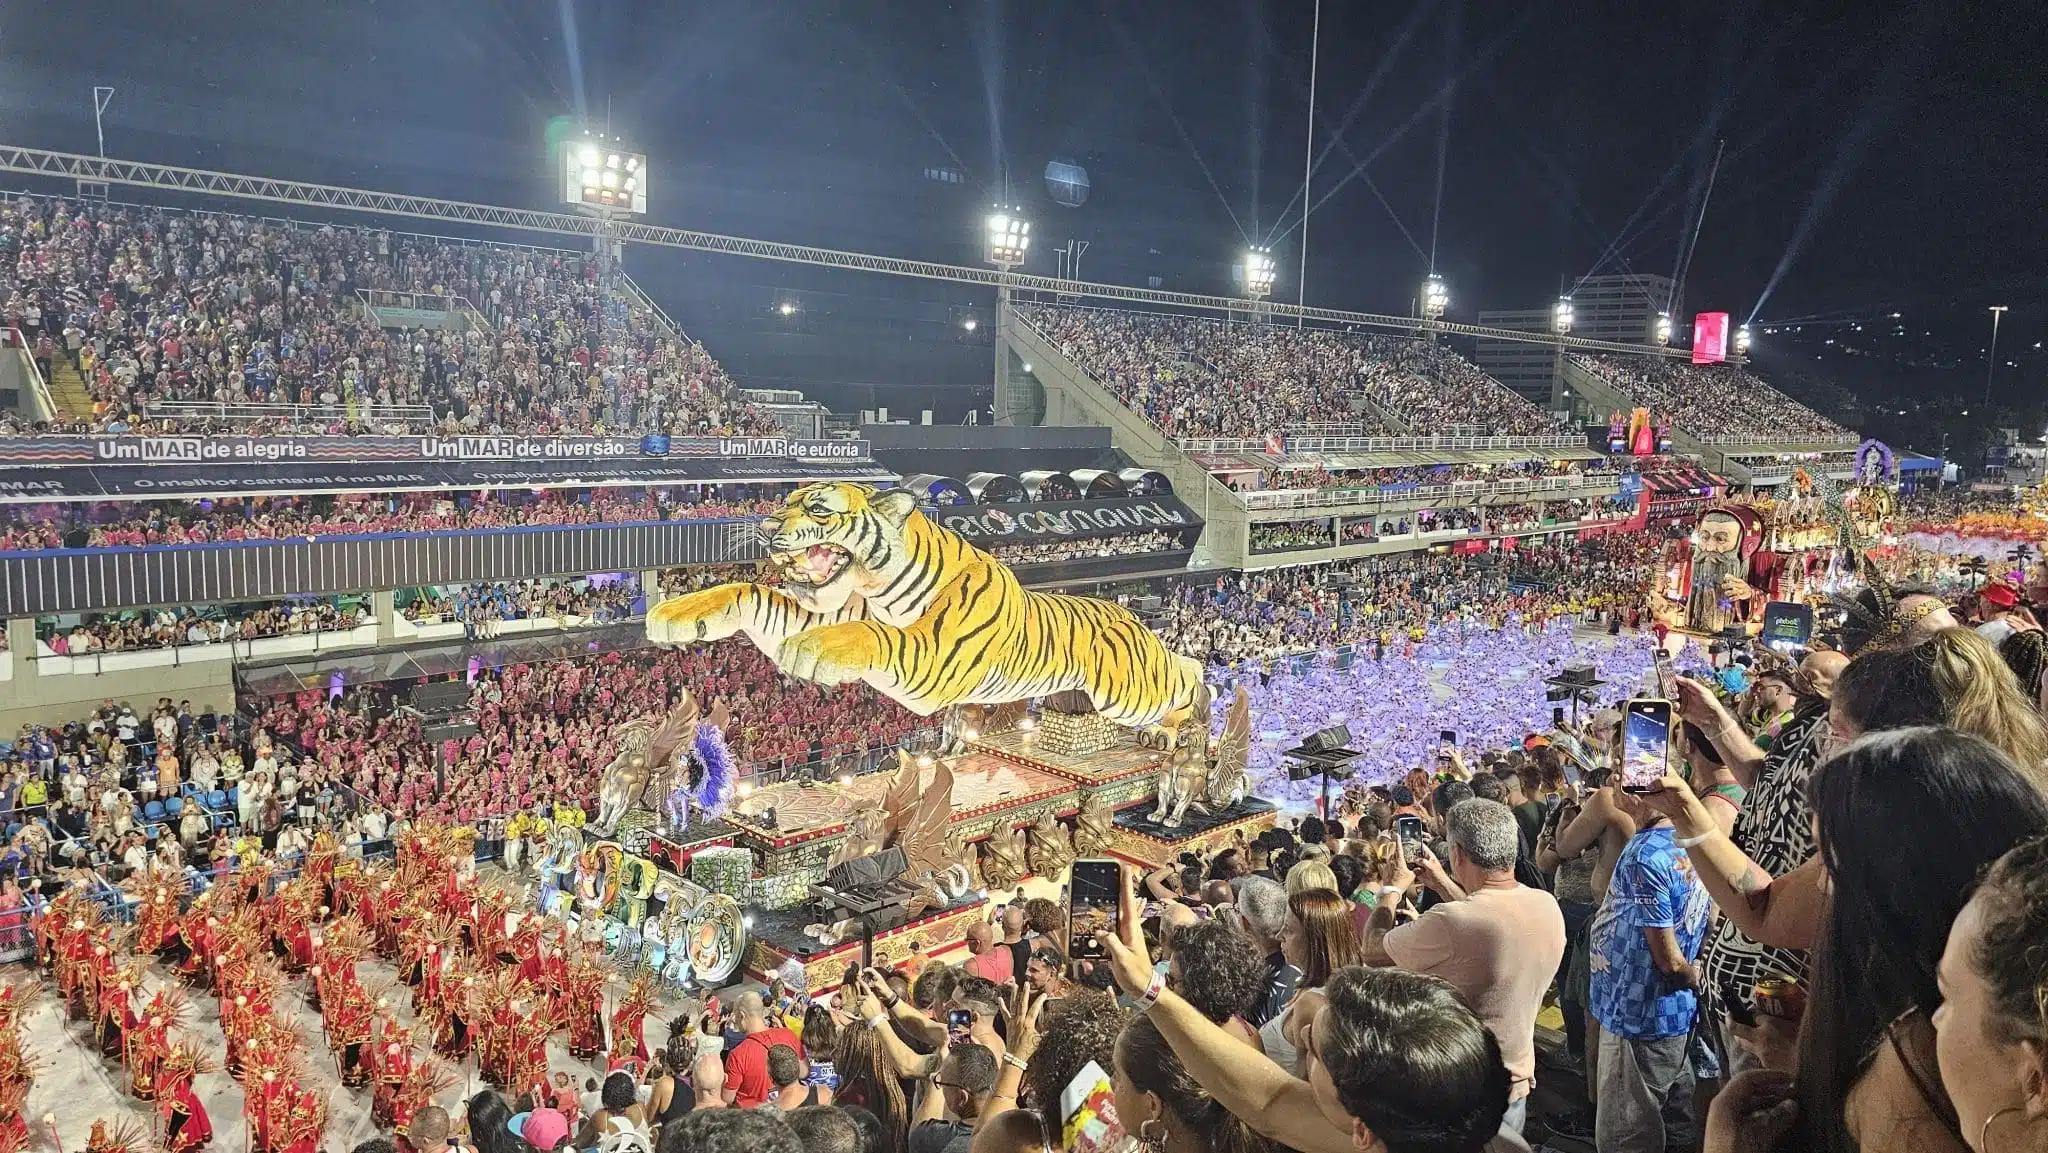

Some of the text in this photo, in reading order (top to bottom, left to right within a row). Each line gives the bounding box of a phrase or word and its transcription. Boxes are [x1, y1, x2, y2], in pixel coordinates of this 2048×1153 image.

[98, 440, 306, 460] Um MAR de alegria
[421, 438, 625, 457] Um MAR de diversão
[719, 439, 859, 457] Um MAR de euforia
[134, 473, 426, 488] O melhor carnaval é no MAR
[490, 471, 551, 480] melhor
[551, 469, 618, 478] carnaval
[650, 467, 689, 475] MAR
[0, 480, 65, 490] MAR
